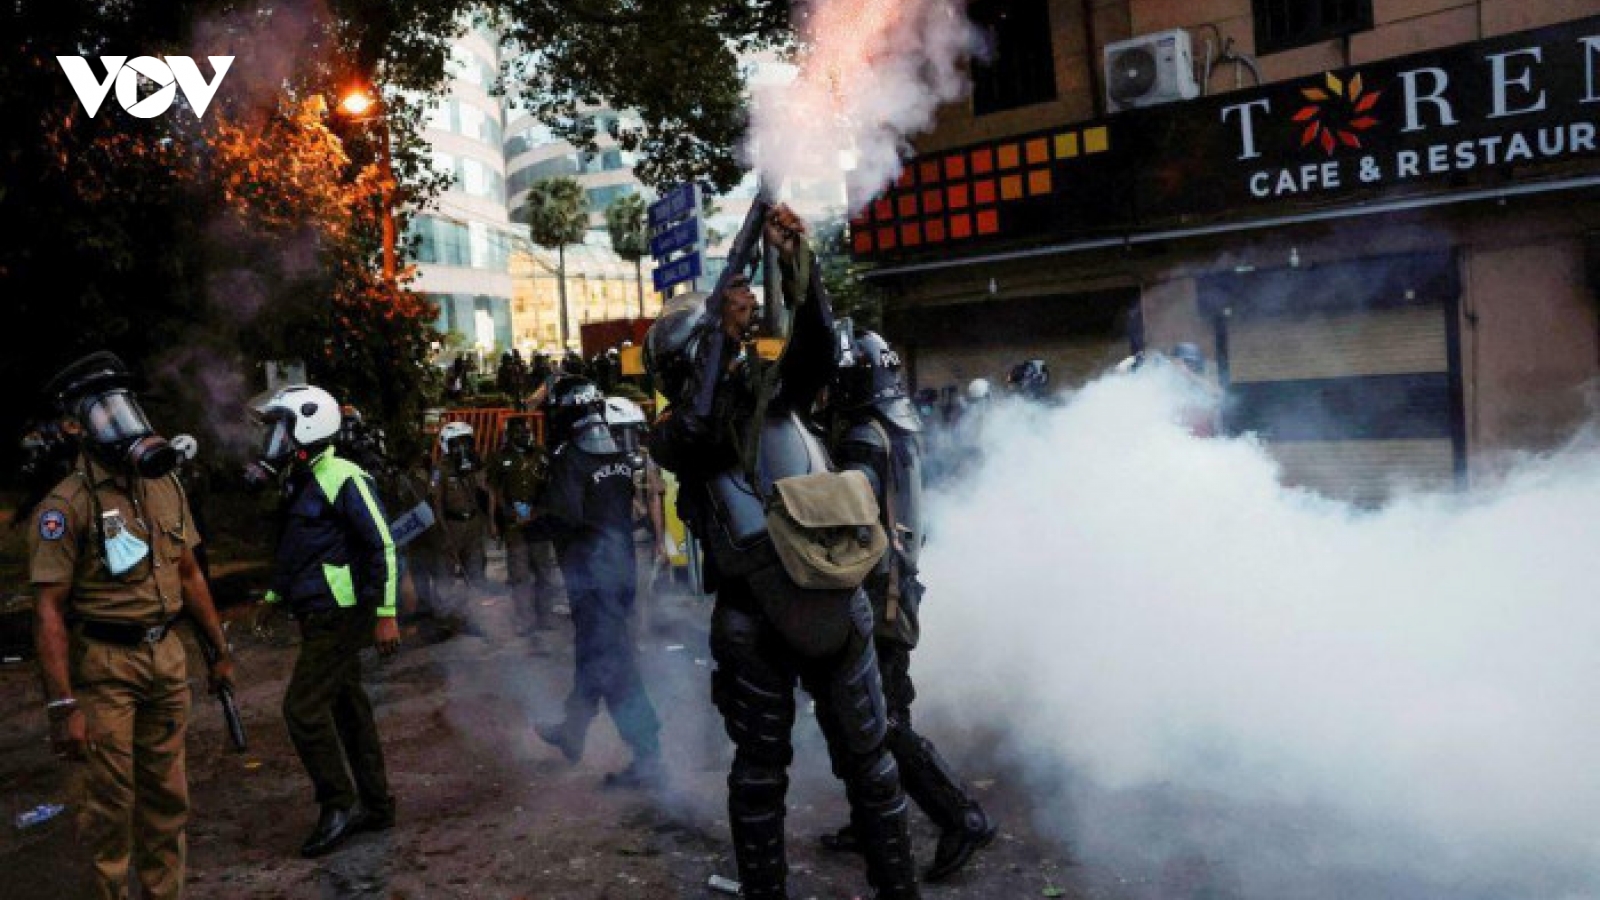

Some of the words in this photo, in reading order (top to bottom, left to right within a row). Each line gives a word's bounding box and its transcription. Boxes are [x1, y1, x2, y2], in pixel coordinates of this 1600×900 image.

[1250, 162, 1340, 197] CAFE
[1359, 156, 1382, 183] &
[1397, 122, 1596, 178] RESTAUR
